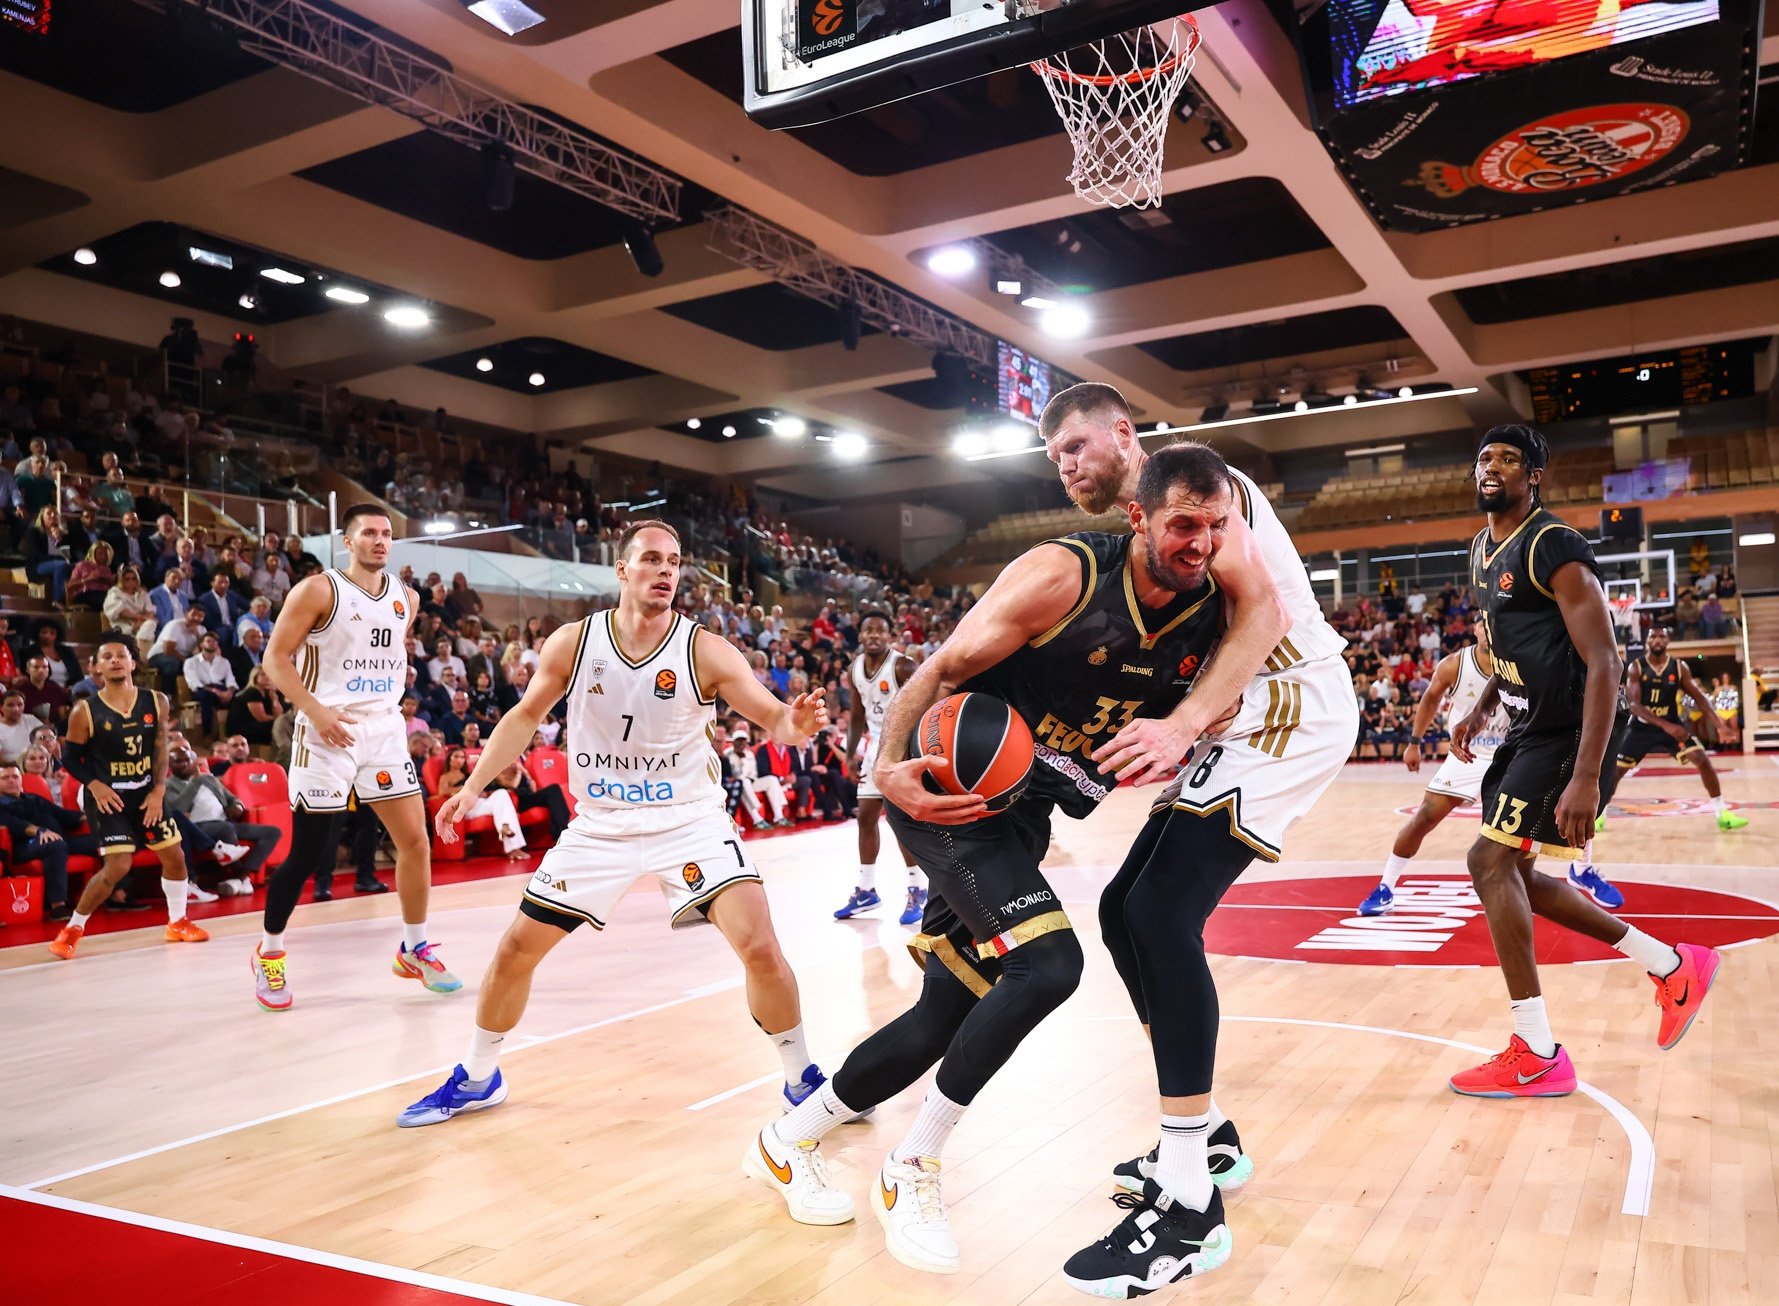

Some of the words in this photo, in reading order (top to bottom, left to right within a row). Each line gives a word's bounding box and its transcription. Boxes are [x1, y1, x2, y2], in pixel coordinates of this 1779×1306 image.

[802, 33, 856, 57] EuroLeague
[370, 628, 392, 648] 30
[1121, 663, 1154, 678] SPALDING
[621, 714, 635, 742] 7
[1082, 696, 1144, 737] 33
[576, 752, 681, 771] OMNIYAT
[1189, 745, 1224, 789] 8
[587, 778, 673, 803] dnata
[1490, 792, 1529, 835] 13
[723, 839, 746, 868] 7
